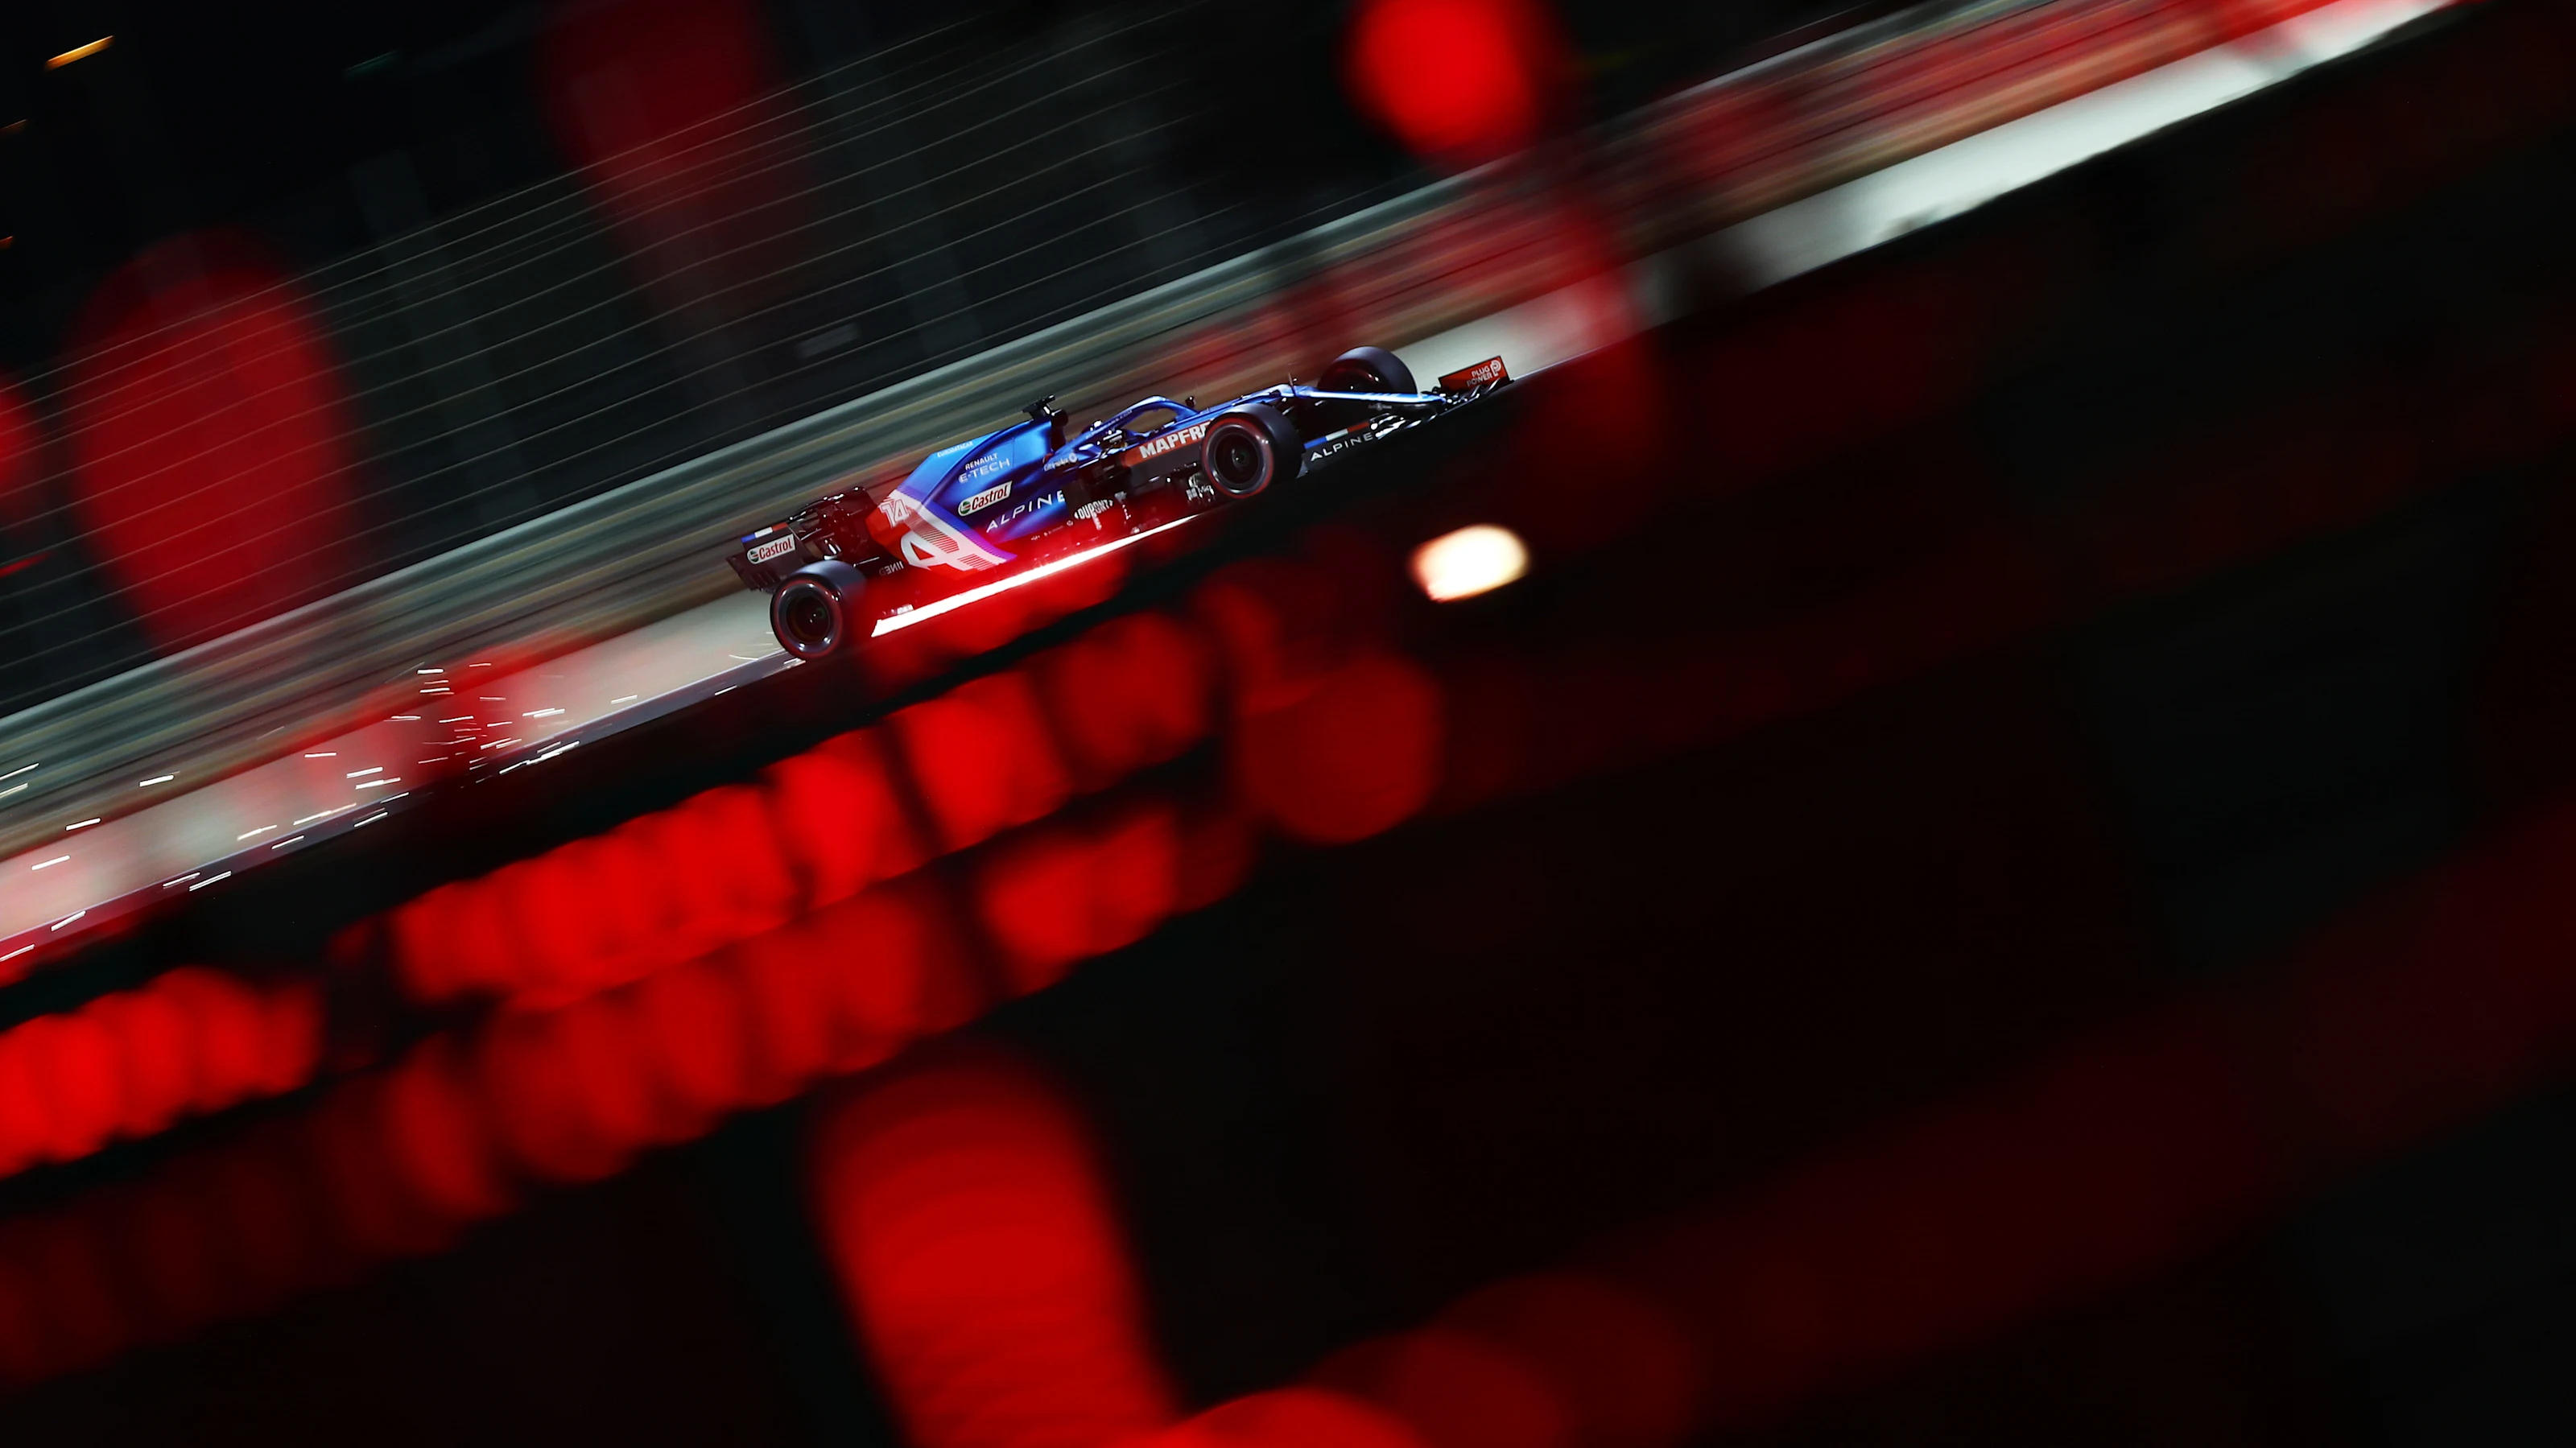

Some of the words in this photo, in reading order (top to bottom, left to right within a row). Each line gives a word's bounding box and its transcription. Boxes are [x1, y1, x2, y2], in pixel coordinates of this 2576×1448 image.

[1466, 373, 1493, 387] POWER
[1472, 365, 1491, 377] PLUG
[1311, 432, 1373, 461] ALPINE
[958, 457, 1010, 483] E-TECH
[965, 452, 998, 470] RENAULT
[972, 485, 1008, 510] Castrol
[877, 499, 910, 528] 14
[986, 490, 1065, 534] ALPINE
[759, 538, 792, 560] Castrol
